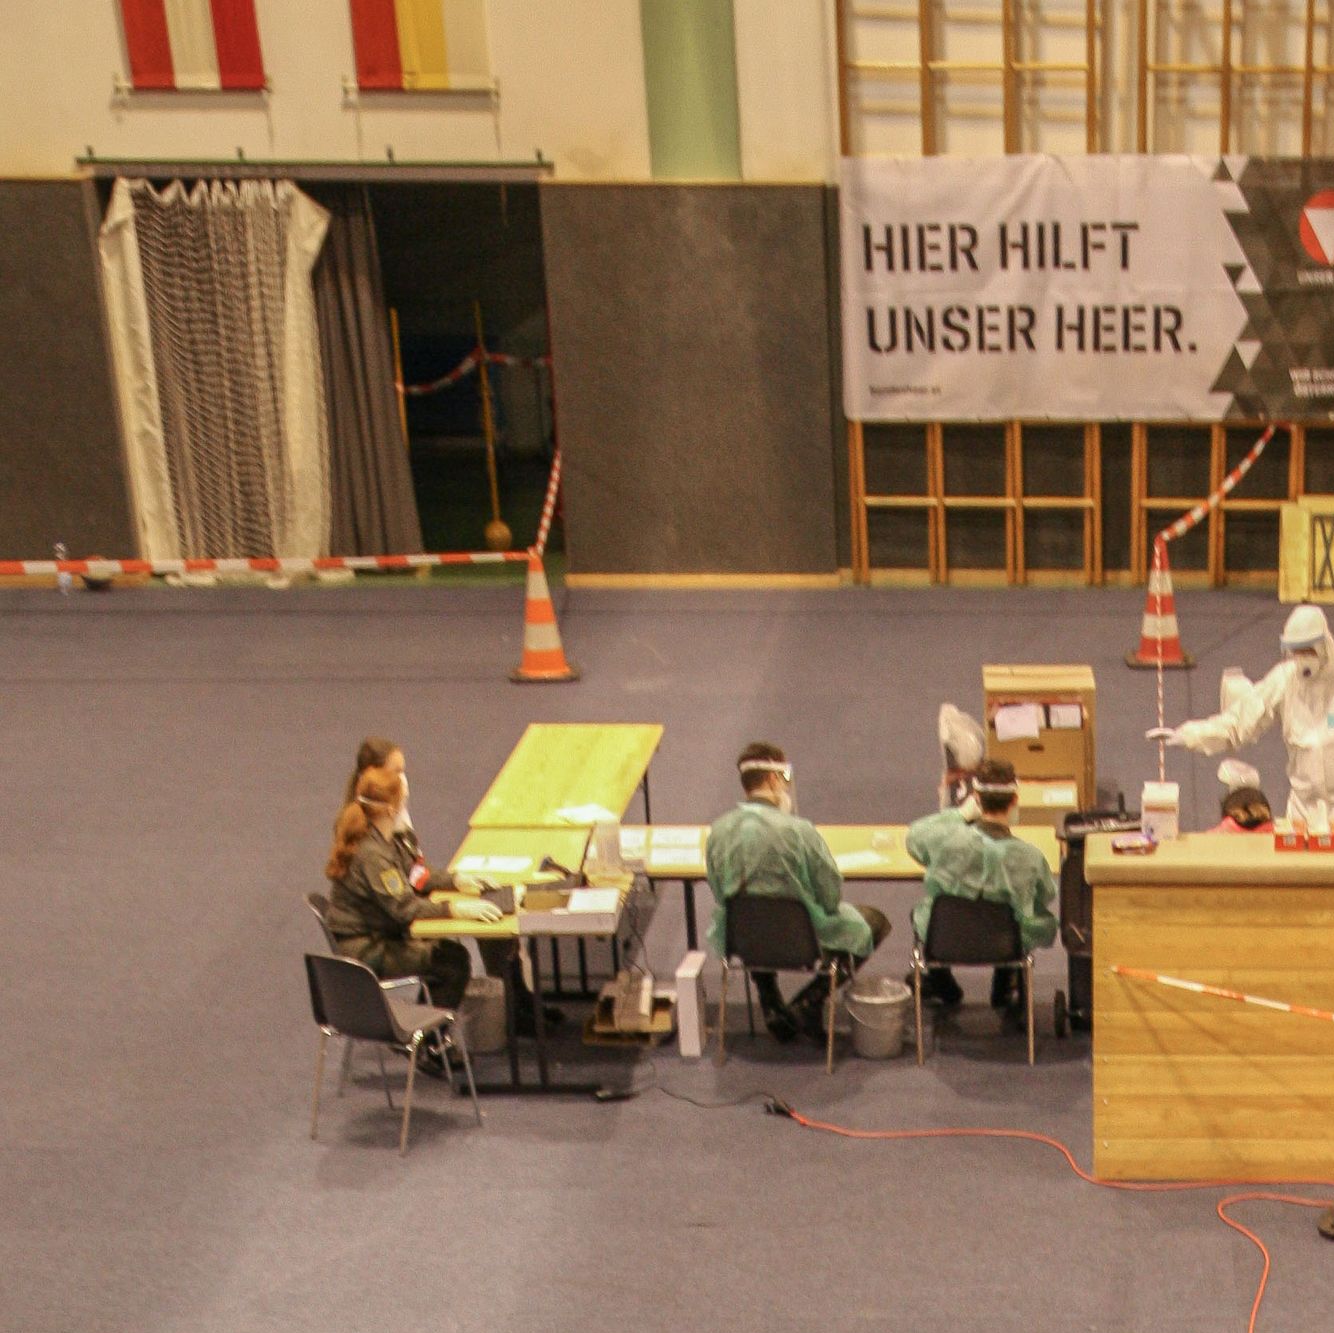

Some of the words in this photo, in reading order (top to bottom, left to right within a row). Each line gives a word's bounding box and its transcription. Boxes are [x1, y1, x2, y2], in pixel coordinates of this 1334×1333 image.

[863, 223, 979, 271] HIER
[999, 221, 1139, 270] HILFT
[867, 305, 1036, 354] UNSER
[1056, 304, 1197, 352] HEER.
